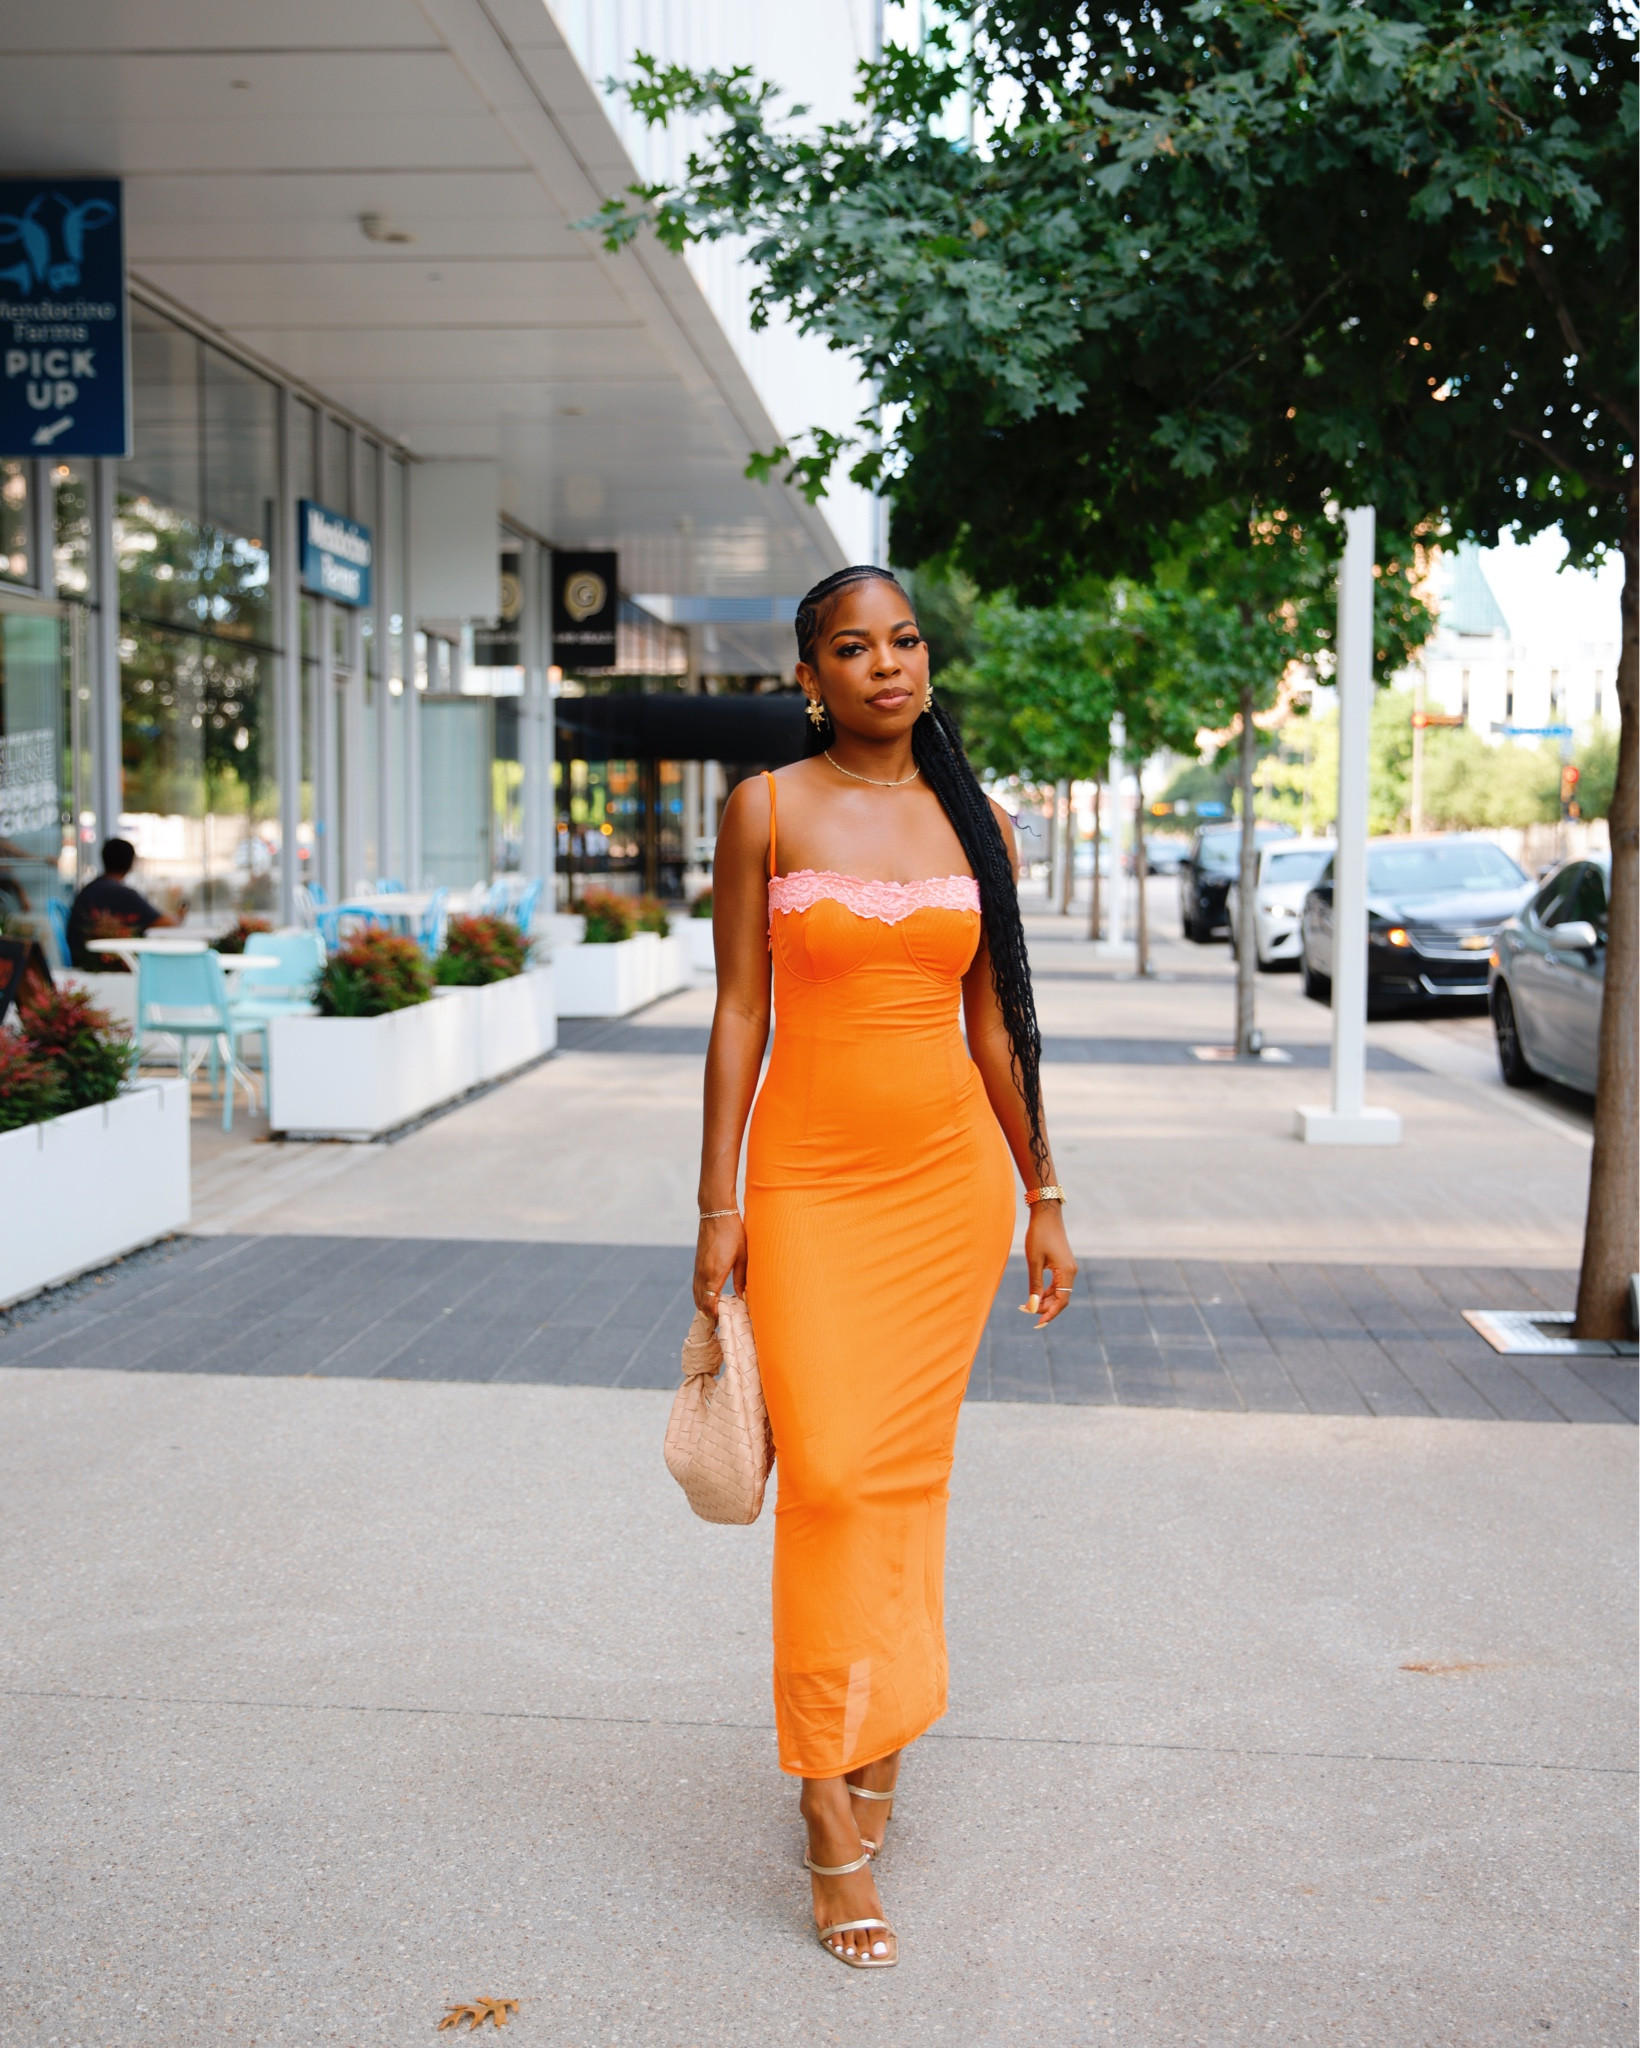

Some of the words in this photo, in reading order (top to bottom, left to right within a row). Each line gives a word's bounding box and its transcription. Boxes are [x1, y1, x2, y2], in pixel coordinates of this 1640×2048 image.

[13, 323, 89, 342] Farms
[5, 349, 97, 378] PICK
[26, 381, 79, 410] UP
